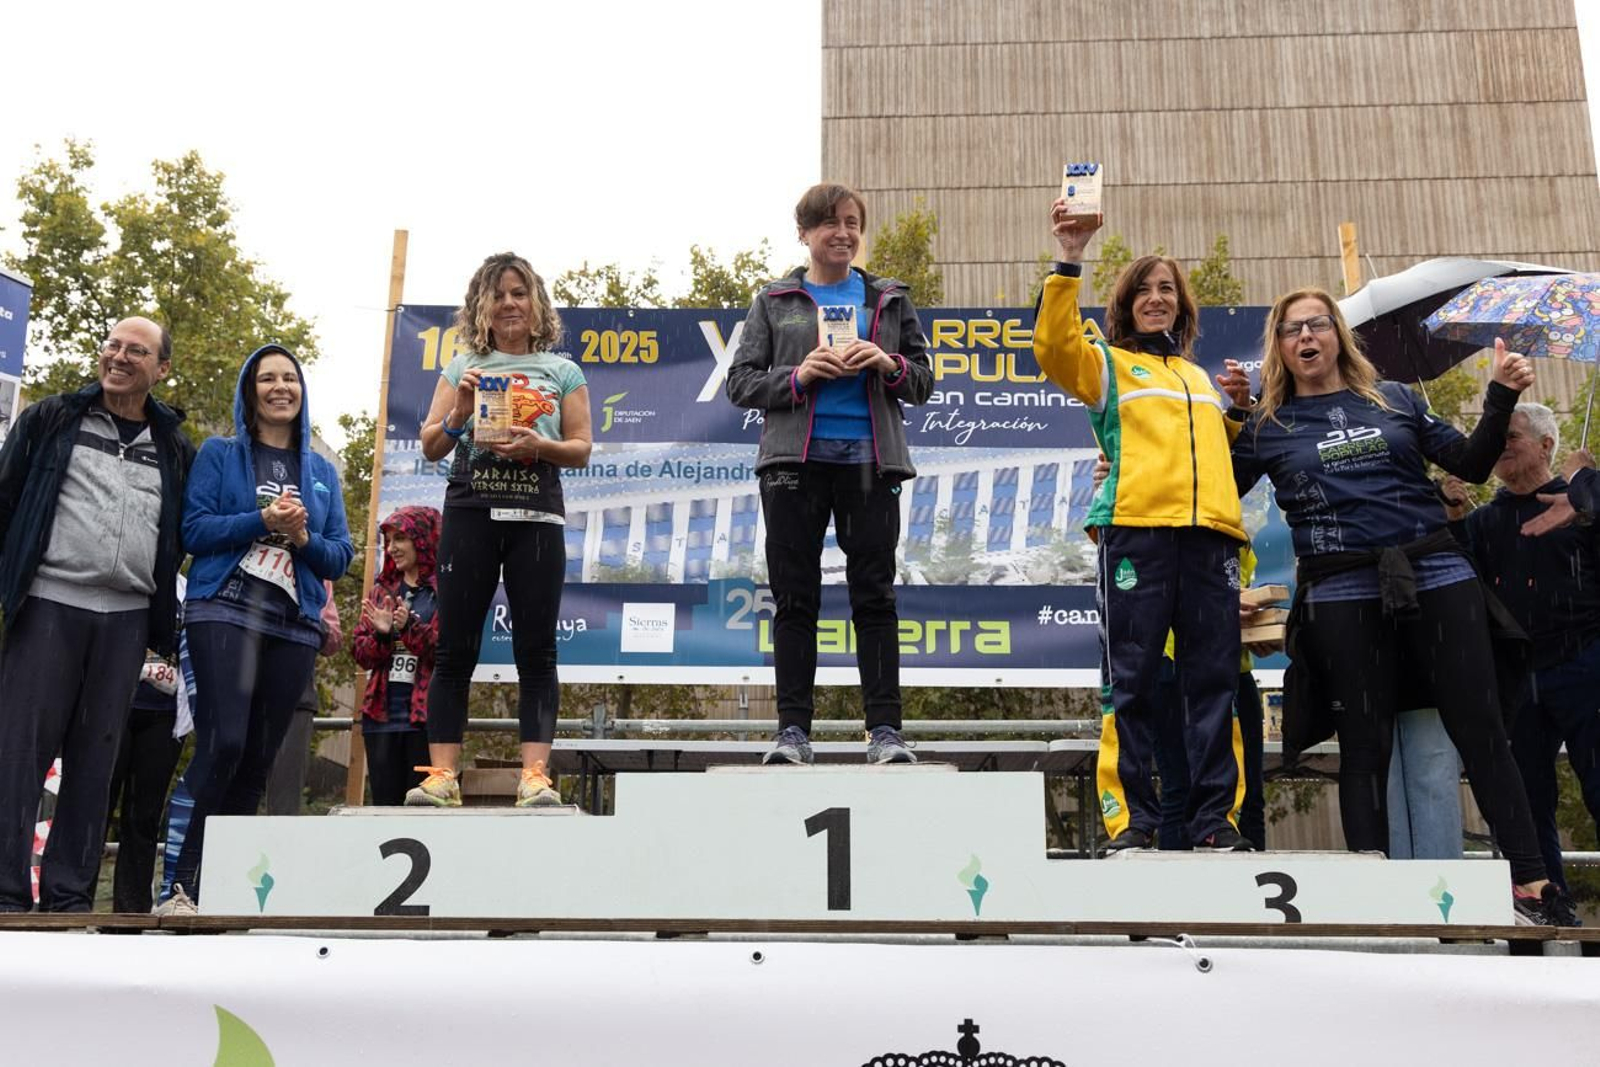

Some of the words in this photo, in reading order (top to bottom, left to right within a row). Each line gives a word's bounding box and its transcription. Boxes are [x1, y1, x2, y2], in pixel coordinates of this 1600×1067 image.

[580, 329, 660, 363] 2025
[920, 408, 1048, 445] Integración
[1317, 426, 1382, 449] 25
[413, 458, 450, 477] IES
[625, 460, 652, 478] de
[658, 460, 758, 484] Alejandr
[374, 837, 431, 916] 2
[804, 807, 851, 910] 1
[1254, 871, 1302, 923] 3
